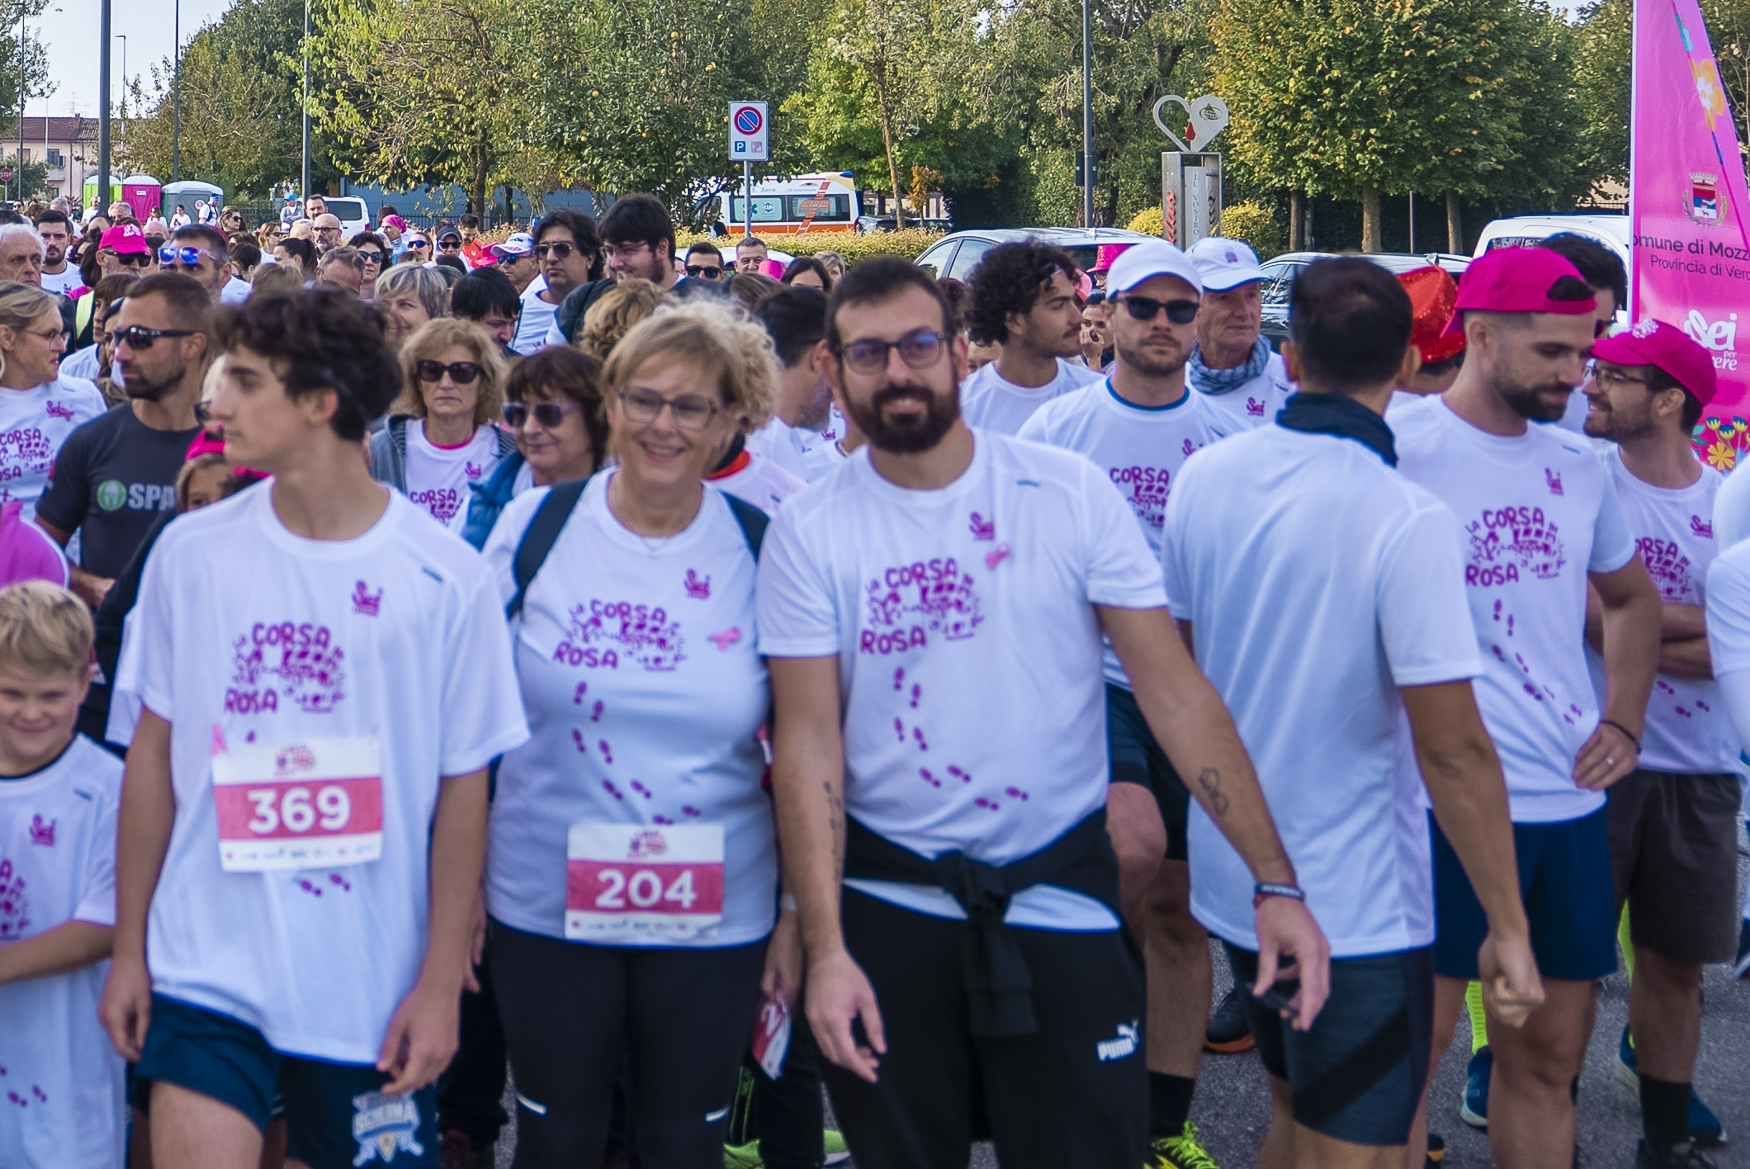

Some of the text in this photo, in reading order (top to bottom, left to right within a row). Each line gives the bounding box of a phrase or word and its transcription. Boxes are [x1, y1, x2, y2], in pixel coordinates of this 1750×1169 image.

[736, 142, 745, 151] P
[1633, 234, 1750, 262] omune di Mozz
[1650, 254, 1750, 280] Provincia di Vero
[1684, 309, 1738, 351] Sei
[1109, 466, 1170, 486] CORSA
[410, 488, 457, 504] CORSA
[1482, 505, 1545, 529] CORSA
[884, 556, 957, 589] CORSA
[1465, 561, 1519, 588] ROSA
[590, 598, 667, 626] CORSA
[251, 622, 332, 650] CORSA
[860, 625, 927, 655] ROSA
[553, 640, 618, 670] ROSA
[223, 687, 279, 714] ROSA
[247, 785, 351, 834] 369
[595, 867, 697, 909] 204
[1097, 1037, 1134, 1061] PUMA
